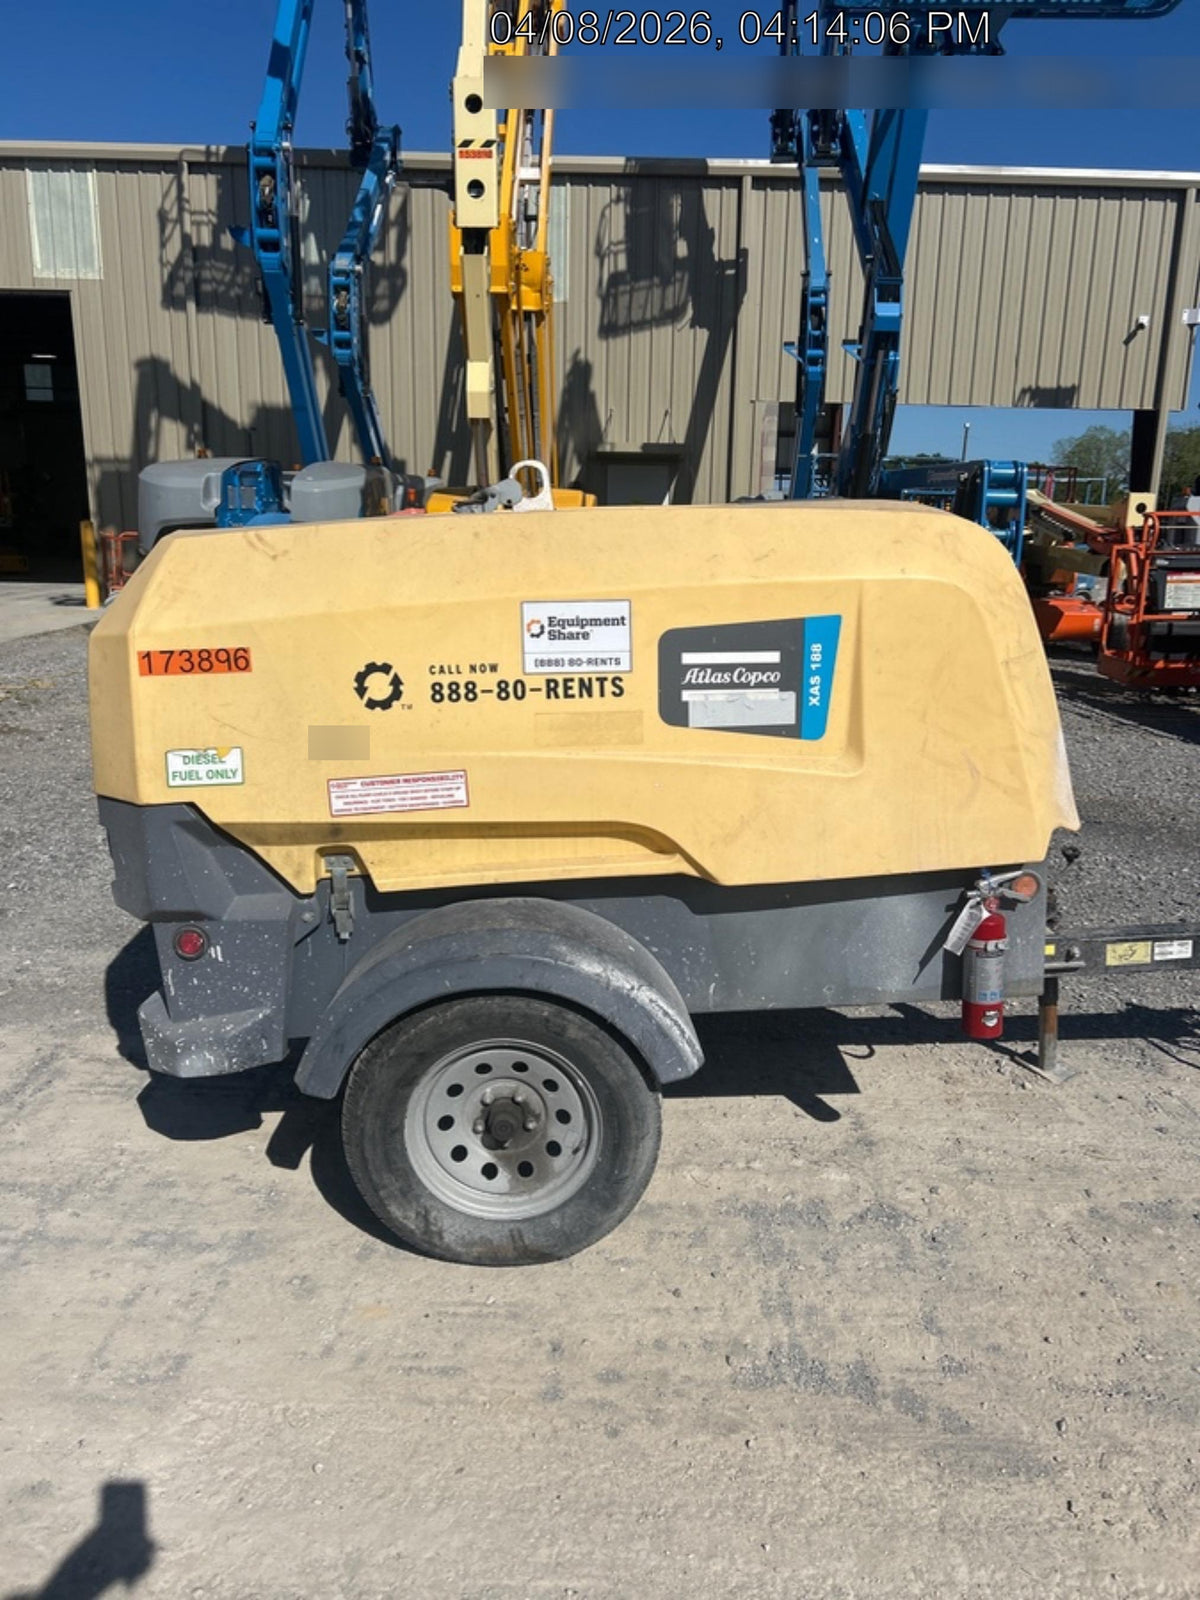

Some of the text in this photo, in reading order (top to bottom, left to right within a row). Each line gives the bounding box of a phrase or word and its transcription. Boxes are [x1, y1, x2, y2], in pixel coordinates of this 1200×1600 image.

[547, 615, 626, 629] Equipment
[547, 629, 591, 641] Share
[141, 647, 250, 674] 173896
[534, 657, 621, 668] (888) 80-RENTS
[428, 662, 499, 675] CALL NOW
[808, 643, 823, 707] XAS 188
[430, 676, 625, 703] 888-80-RENTS
[171, 767, 238, 781] FUEL ONLY
